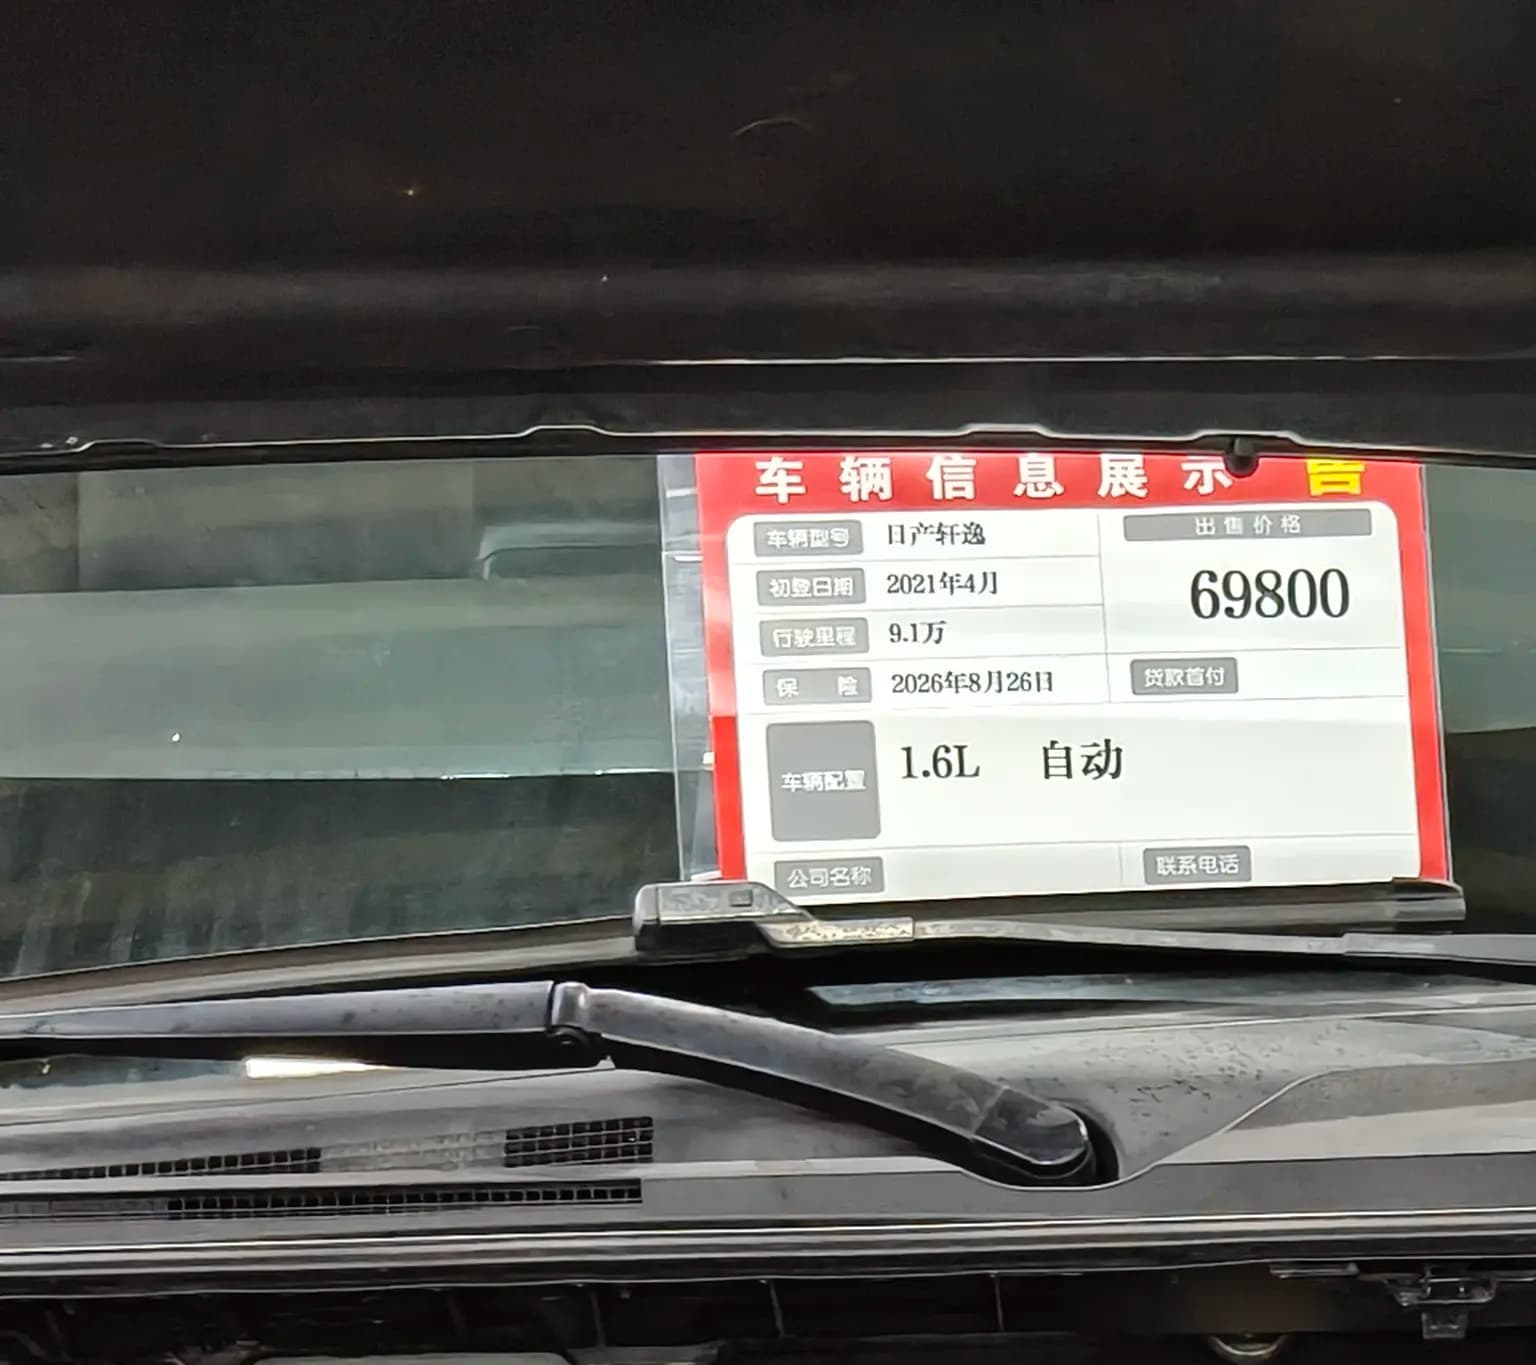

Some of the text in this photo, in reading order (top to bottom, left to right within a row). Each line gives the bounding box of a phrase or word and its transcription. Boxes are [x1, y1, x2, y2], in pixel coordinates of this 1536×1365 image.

[755, 454, 1233, 503] 车辆信息展示
[887, 521, 987, 547] 日产轩逸
[1195, 514, 1302, 536] 出售价格
[767, 527, 850, 549] 车辆型号
[769, 577, 854, 598] 初登日期
[886, 571, 998, 596] 2021年4月
[1190, 568, 1350, 619] 69800
[773, 626, 857, 648] 行驶里程
[888, 620, 948, 645] 9.1万
[891, 670, 1054, 694] 2026年8月26日
[1144, 666, 1226, 688] 贷款首付
[901, 738, 1123, 780] 1.6L 自动
[781, 769, 867, 793] 车辆配置
[1156, 853, 1240, 876] 联系电话
[787, 865, 873, 889] 公司名称
